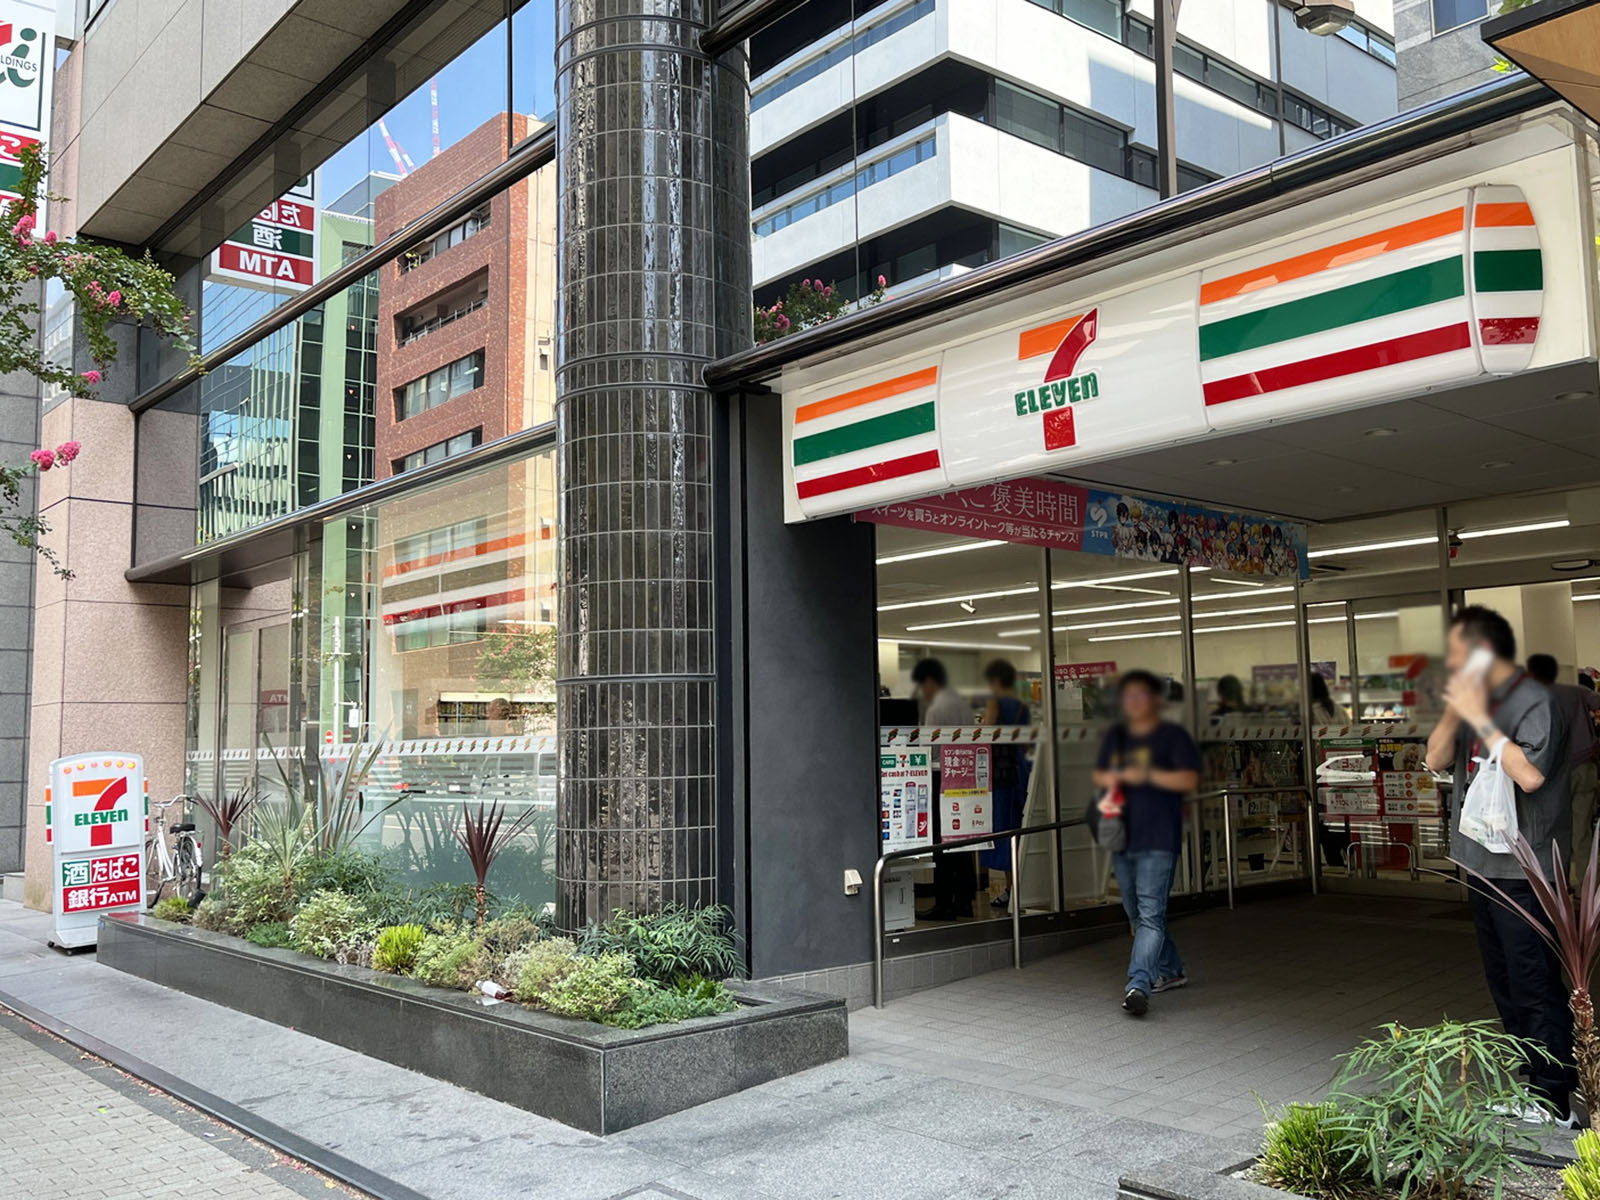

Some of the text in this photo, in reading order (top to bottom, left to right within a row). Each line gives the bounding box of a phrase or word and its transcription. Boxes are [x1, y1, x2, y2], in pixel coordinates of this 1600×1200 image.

[64, 857, 139, 886] 酒 たばこ
